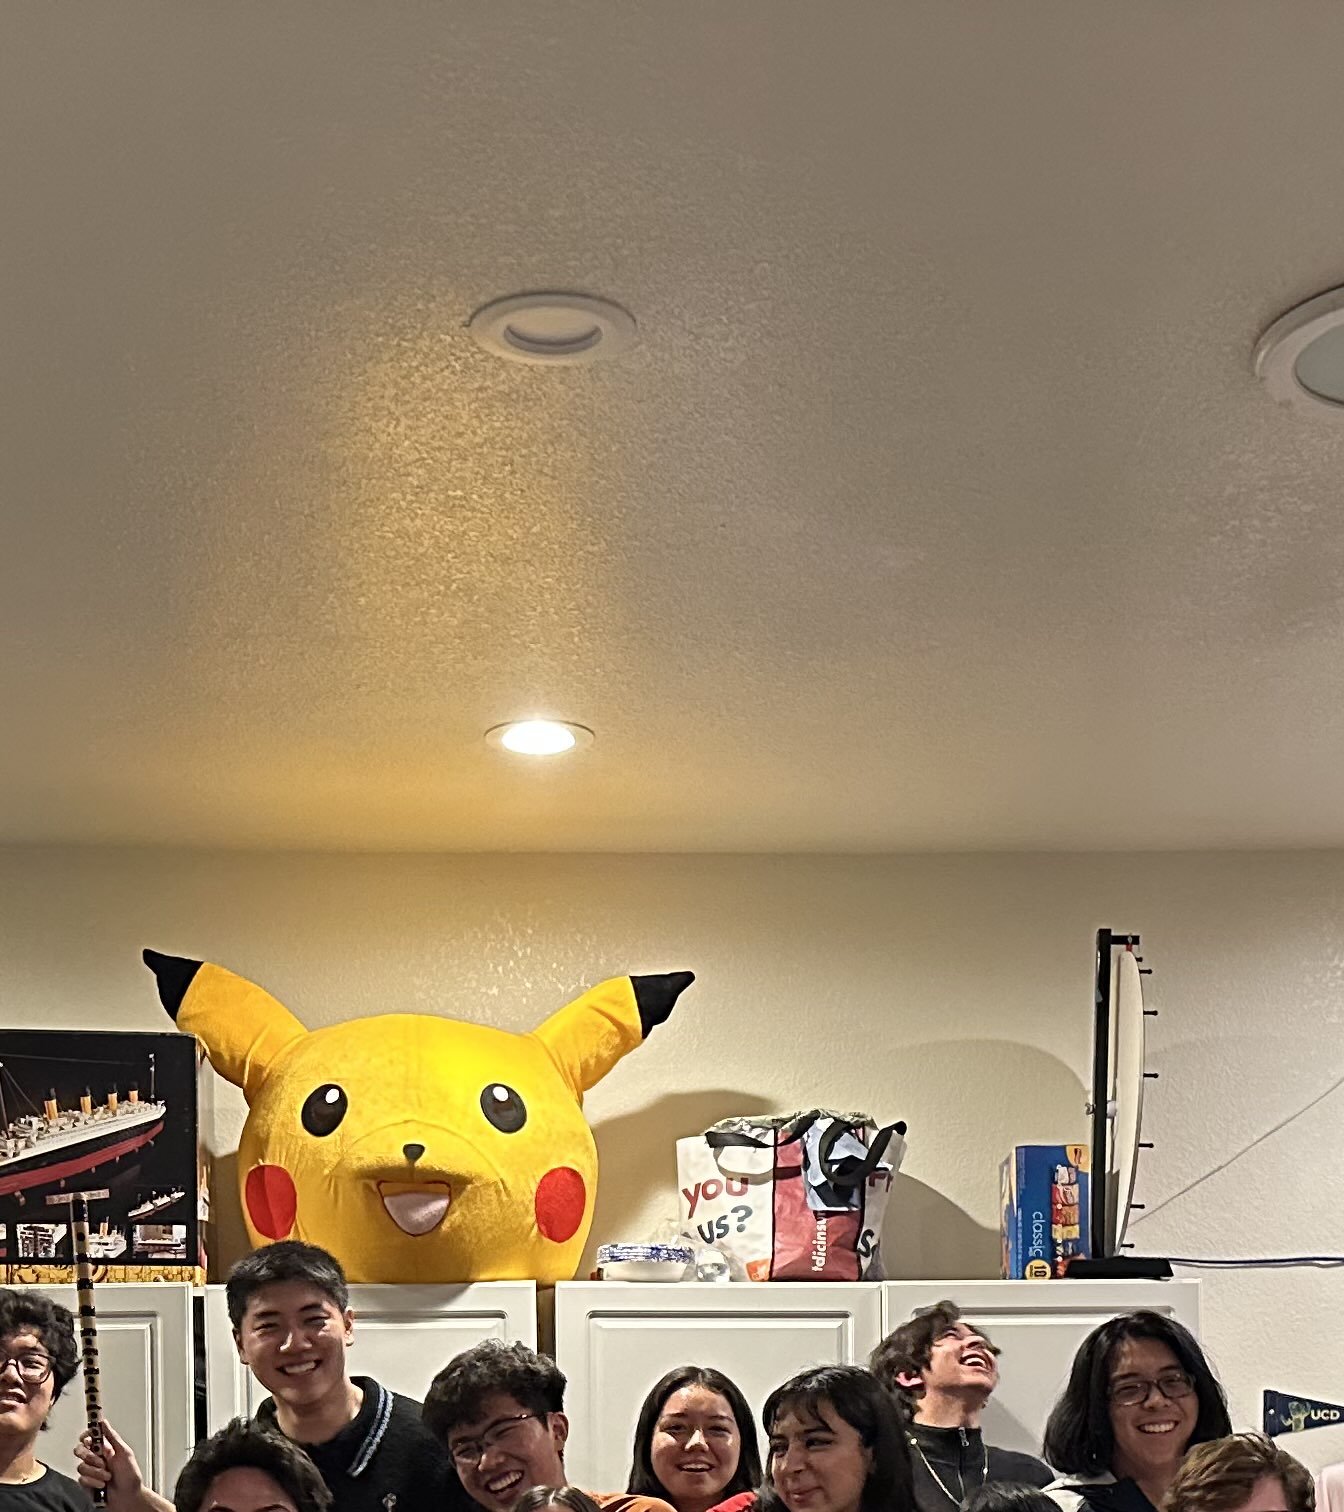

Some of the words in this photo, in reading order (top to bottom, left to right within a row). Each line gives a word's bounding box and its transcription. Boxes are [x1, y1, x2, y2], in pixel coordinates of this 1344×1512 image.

[811, 1212, 827, 1272] tdicinsu
[1032, 1211, 1046, 1257] classic
[1310, 1409, 1341, 1421] UCD
